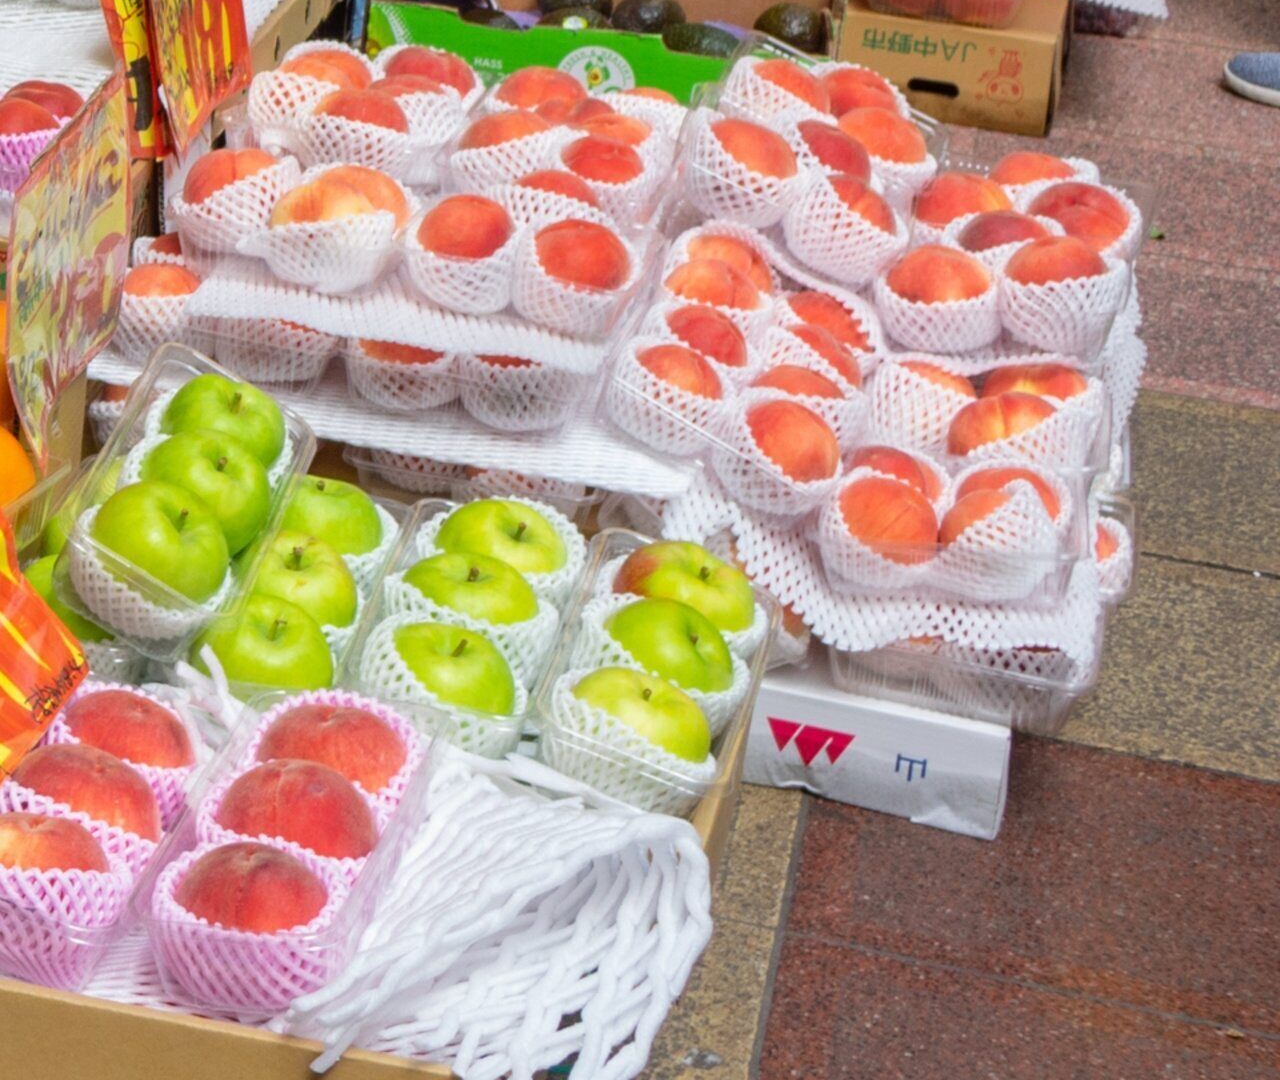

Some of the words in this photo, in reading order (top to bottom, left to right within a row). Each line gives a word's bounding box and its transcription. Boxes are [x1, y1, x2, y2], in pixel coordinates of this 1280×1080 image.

[860, 27, 981, 67] JA中野市
[473, 55, 503, 70] HASS
